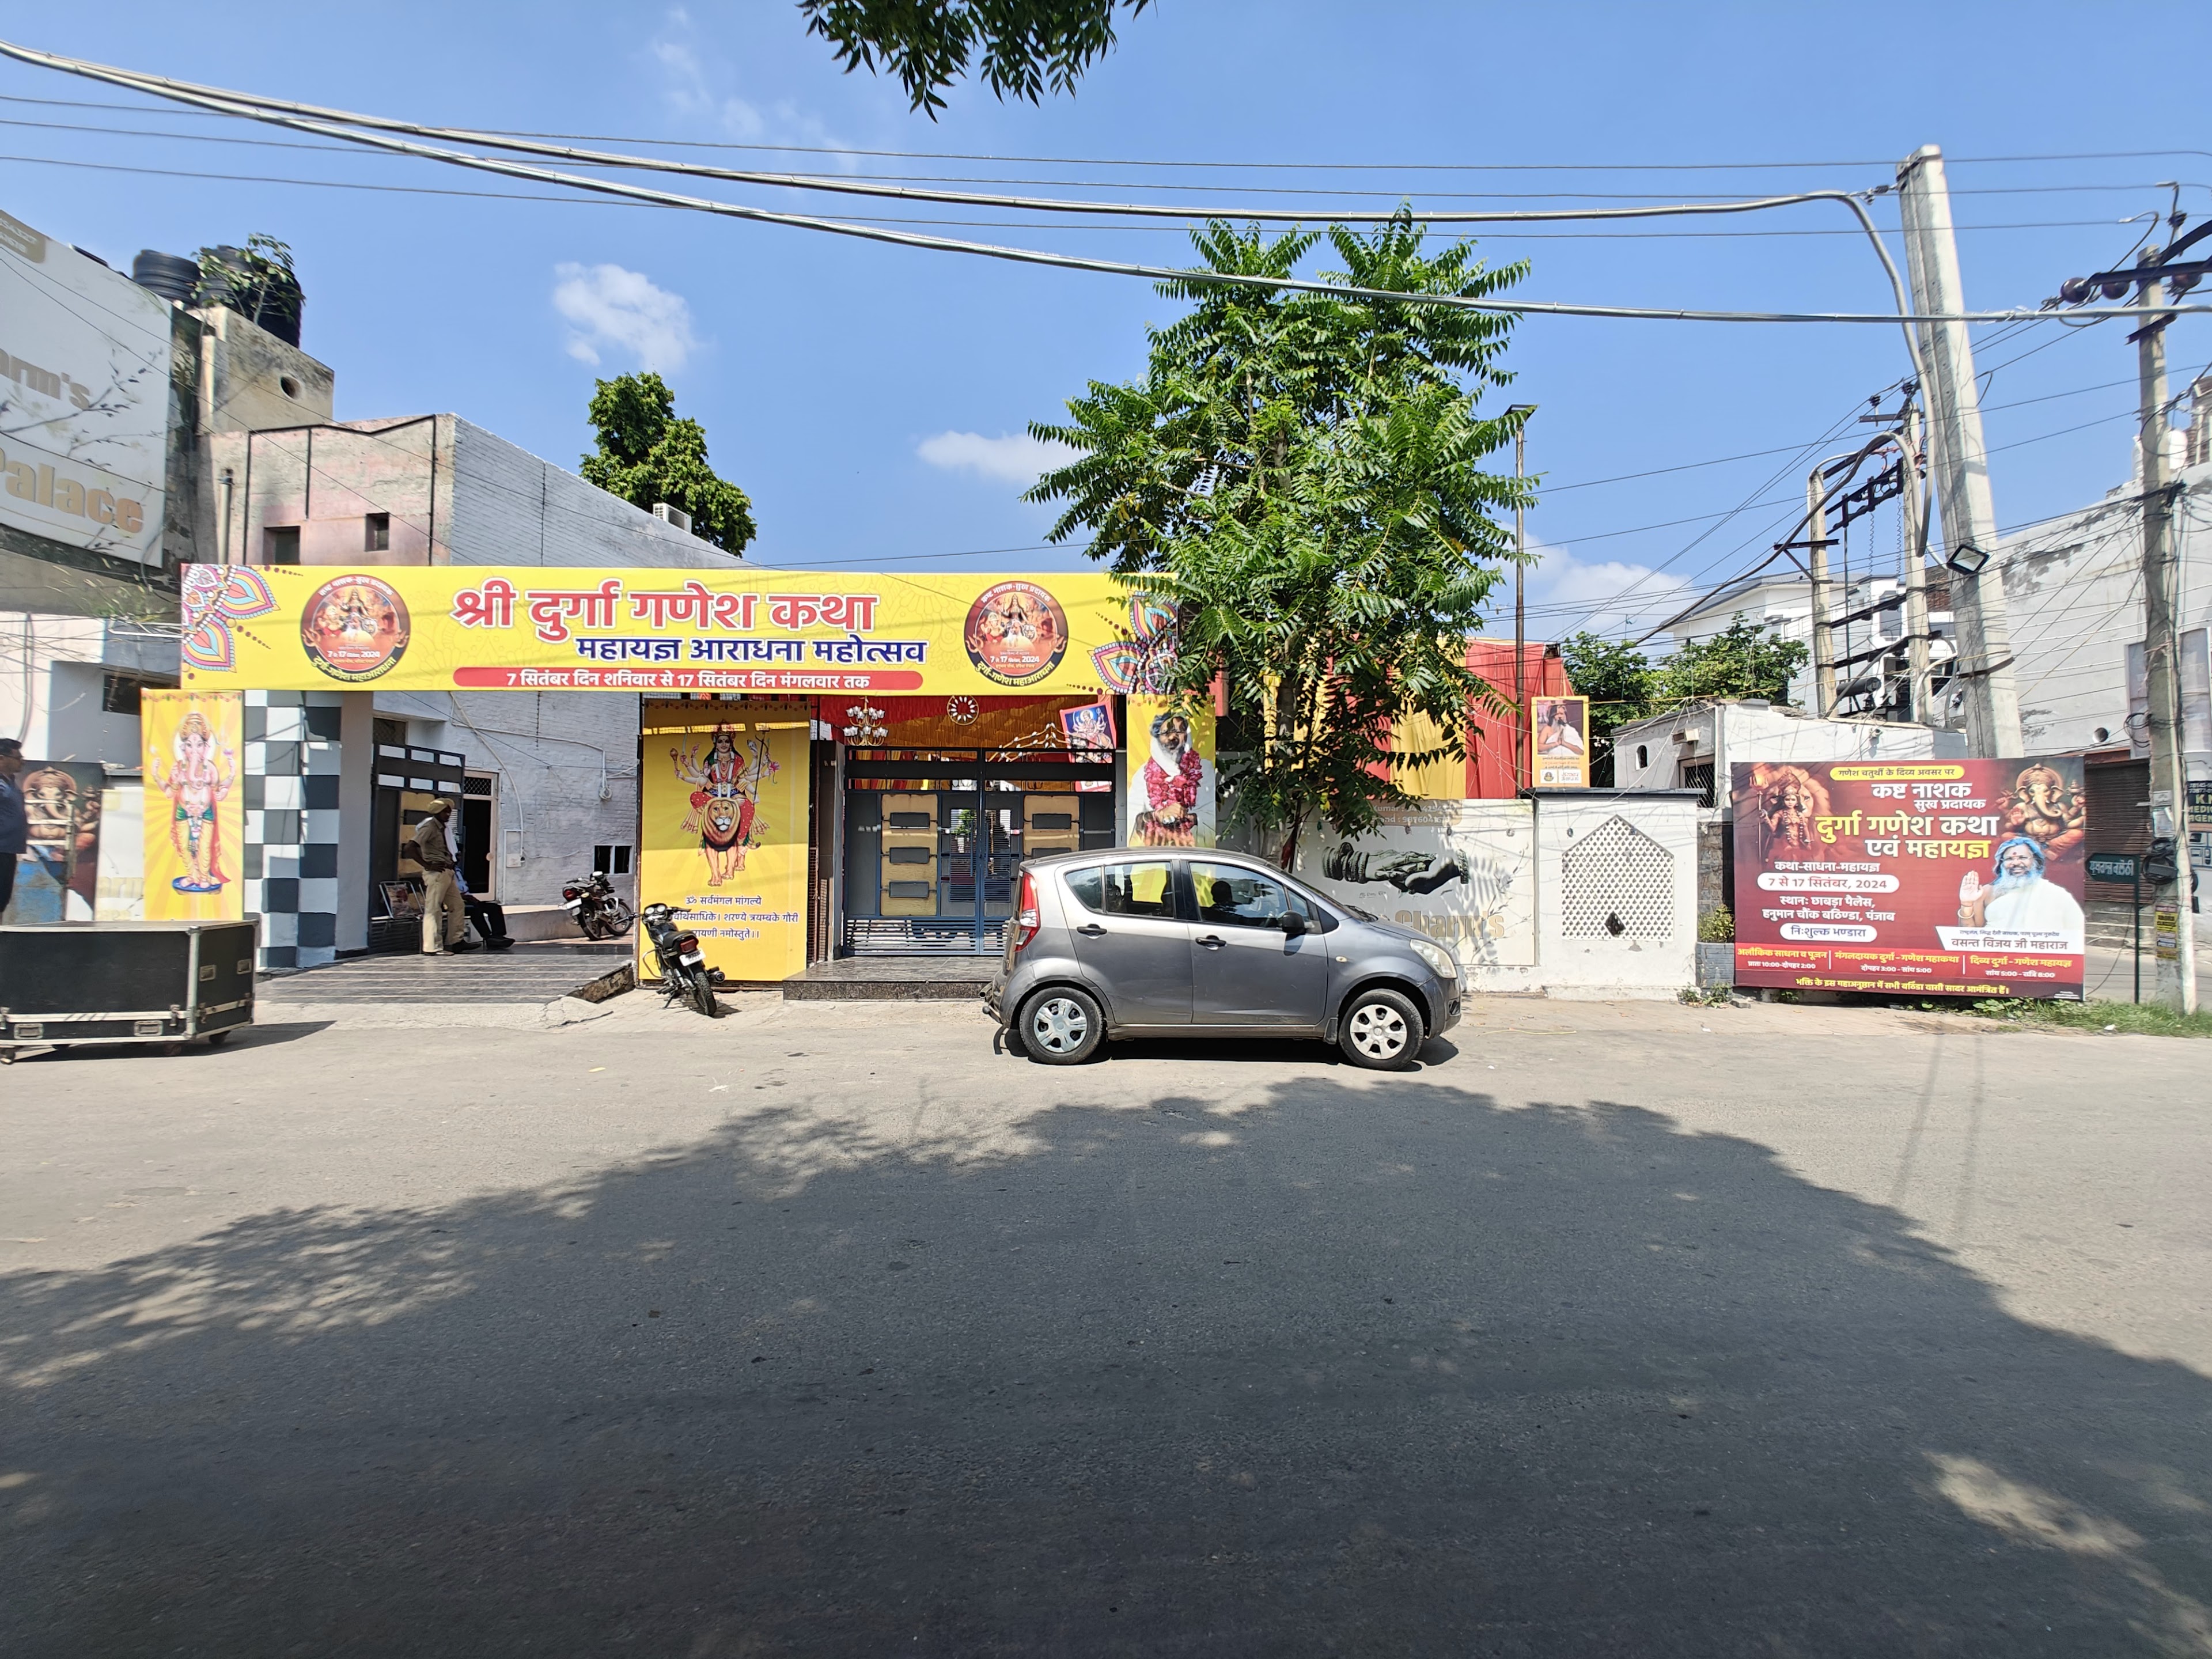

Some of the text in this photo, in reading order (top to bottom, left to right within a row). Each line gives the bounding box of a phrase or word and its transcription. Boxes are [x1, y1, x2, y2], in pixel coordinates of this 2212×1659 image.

[0, 447, 143, 533] alace
[453, 580, 877, 641] श्री दुर्गा गणेश कथा
[576, 634, 927, 662] महायज्ञ आराधना महोत्सव
[507, 669, 871, 688] 7 सितंबर दिन शनिवार से 17 सितंबर दिन मंगलवार तक
[1839, 767, 1859, 777] गणेश
[1886, 767, 1894, 776] के
[1896, 767, 1915, 776] दिव्य
[1872, 783, 1972, 799] कष्ट नाशक
[1914, 800, 1987, 813] सुख प्रदायक
[1815, 810, 2000, 843] दुर्गा गणेश कथा
[1865, 834, 1991, 859] एवं महायज्ञ
[1774, 861, 1880, 872] कथा-साधना-महायज्ञ
[1768, 878, 1775, 886] 7
[1779, 876, 1788, 887] से
[1793, 878, 1804, 887] 17
[1856, 880, 1887, 888] 2024
[686, 895, 762, 905] ॐ सर्वमंगल मांगल्ये
[1810, 896, 1843, 907] छाबड़ा
[724, 912, 747, 921] शरण्ये
[749, 912, 780, 922] त्रयम्बके
[1762, 909, 1794, 921] हनुमान
[1865, 910, 1896, 921] पंजाब
[1395, 910, 1505, 938] Charm's
[692, 927, 717, 937] रायणी
[1833, 929, 1866, 937] भण्डारा
[1951, 937, 2068, 950] वसन्त विजय जी महाराज
[1737, 947, 1774, 956] अलौकिक
[1808, 951, 1828, 960] पूजन
[1834, 950, 1878, 960] मंगलदायक
[1879, 952, 1895, 963] दुर्गा
[1901, 953, 1924, 962] गणेश
[1970, 955, 1990, 964] दिव्य
[1991, 955, 2008, 968] दुर्गा
[2014, 957, 2039, 966] गणेश
